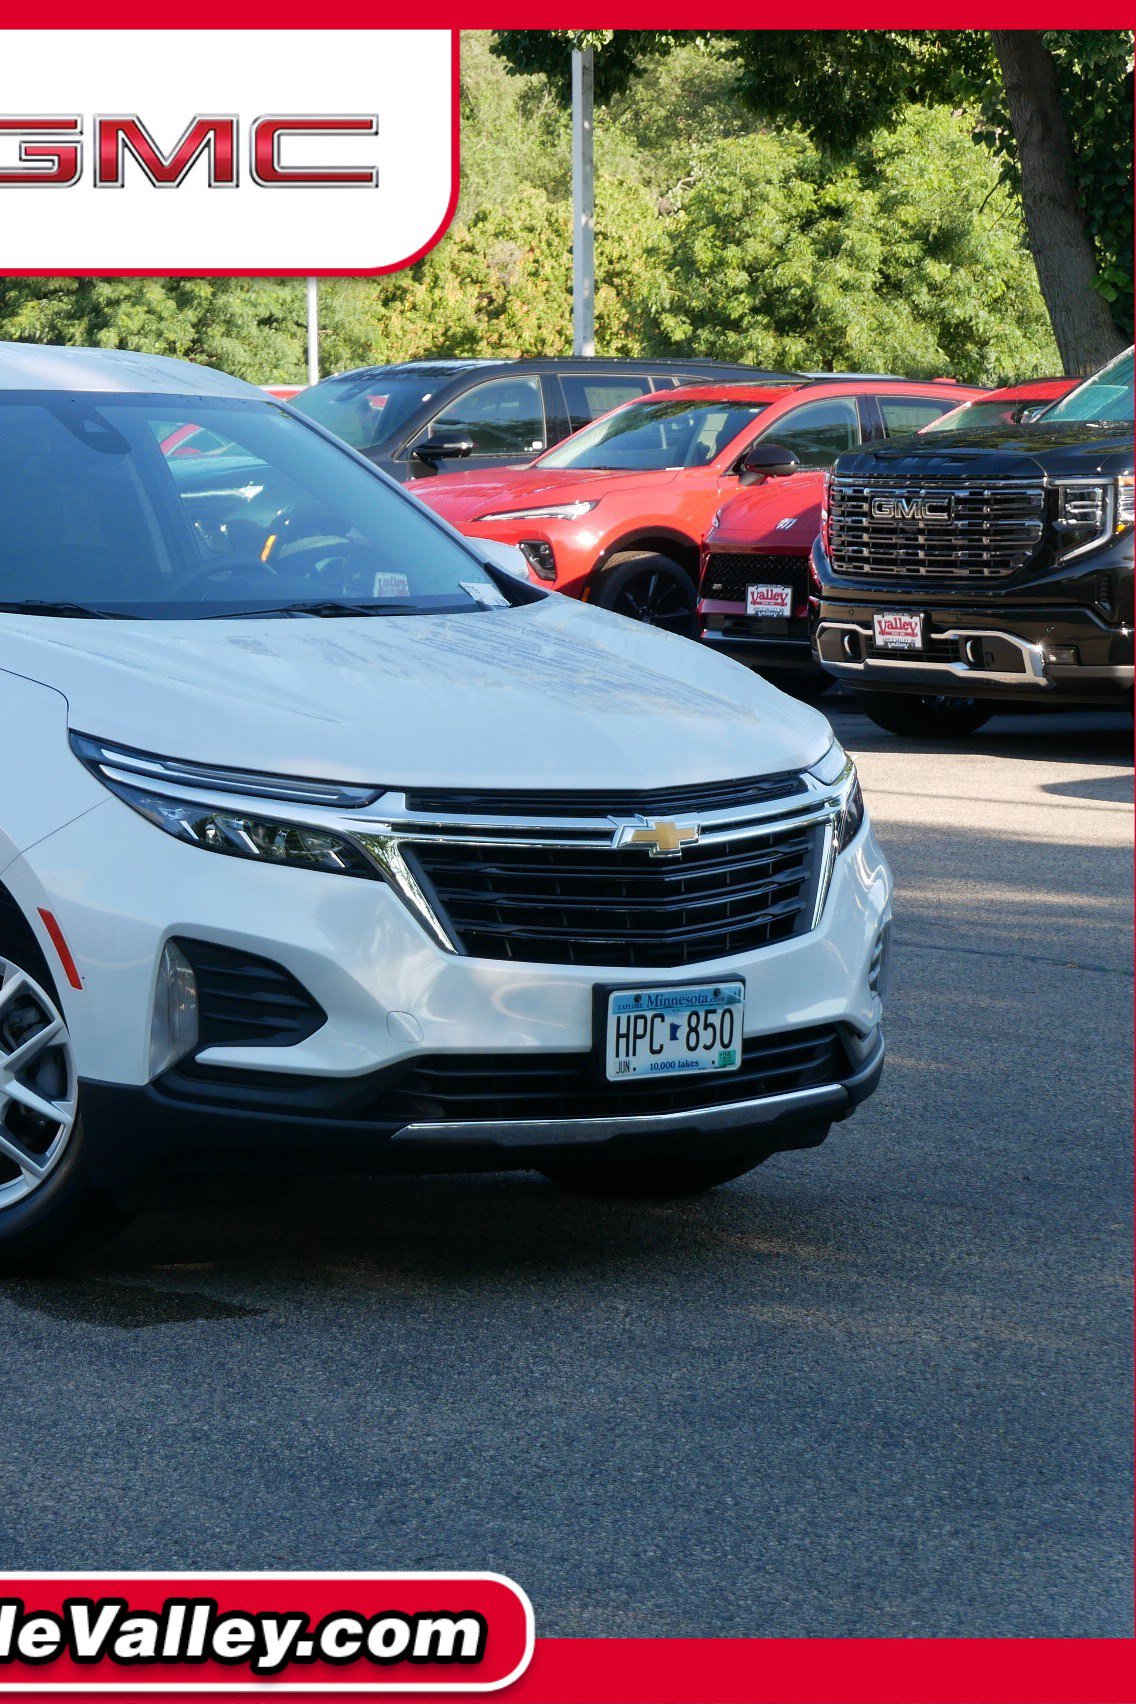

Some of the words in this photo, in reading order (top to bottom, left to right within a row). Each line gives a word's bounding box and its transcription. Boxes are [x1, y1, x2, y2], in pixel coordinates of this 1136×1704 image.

[871, 497, 949, 519] GMC
[615, 1012, 665, 1058] HPC
[685, 1008, 734, 1052] 850
[616, 1060, 630, 1074] JUN
[649, 1061, 675, 1071] 10,000
[678, 1059, 700, 1068] lakes
